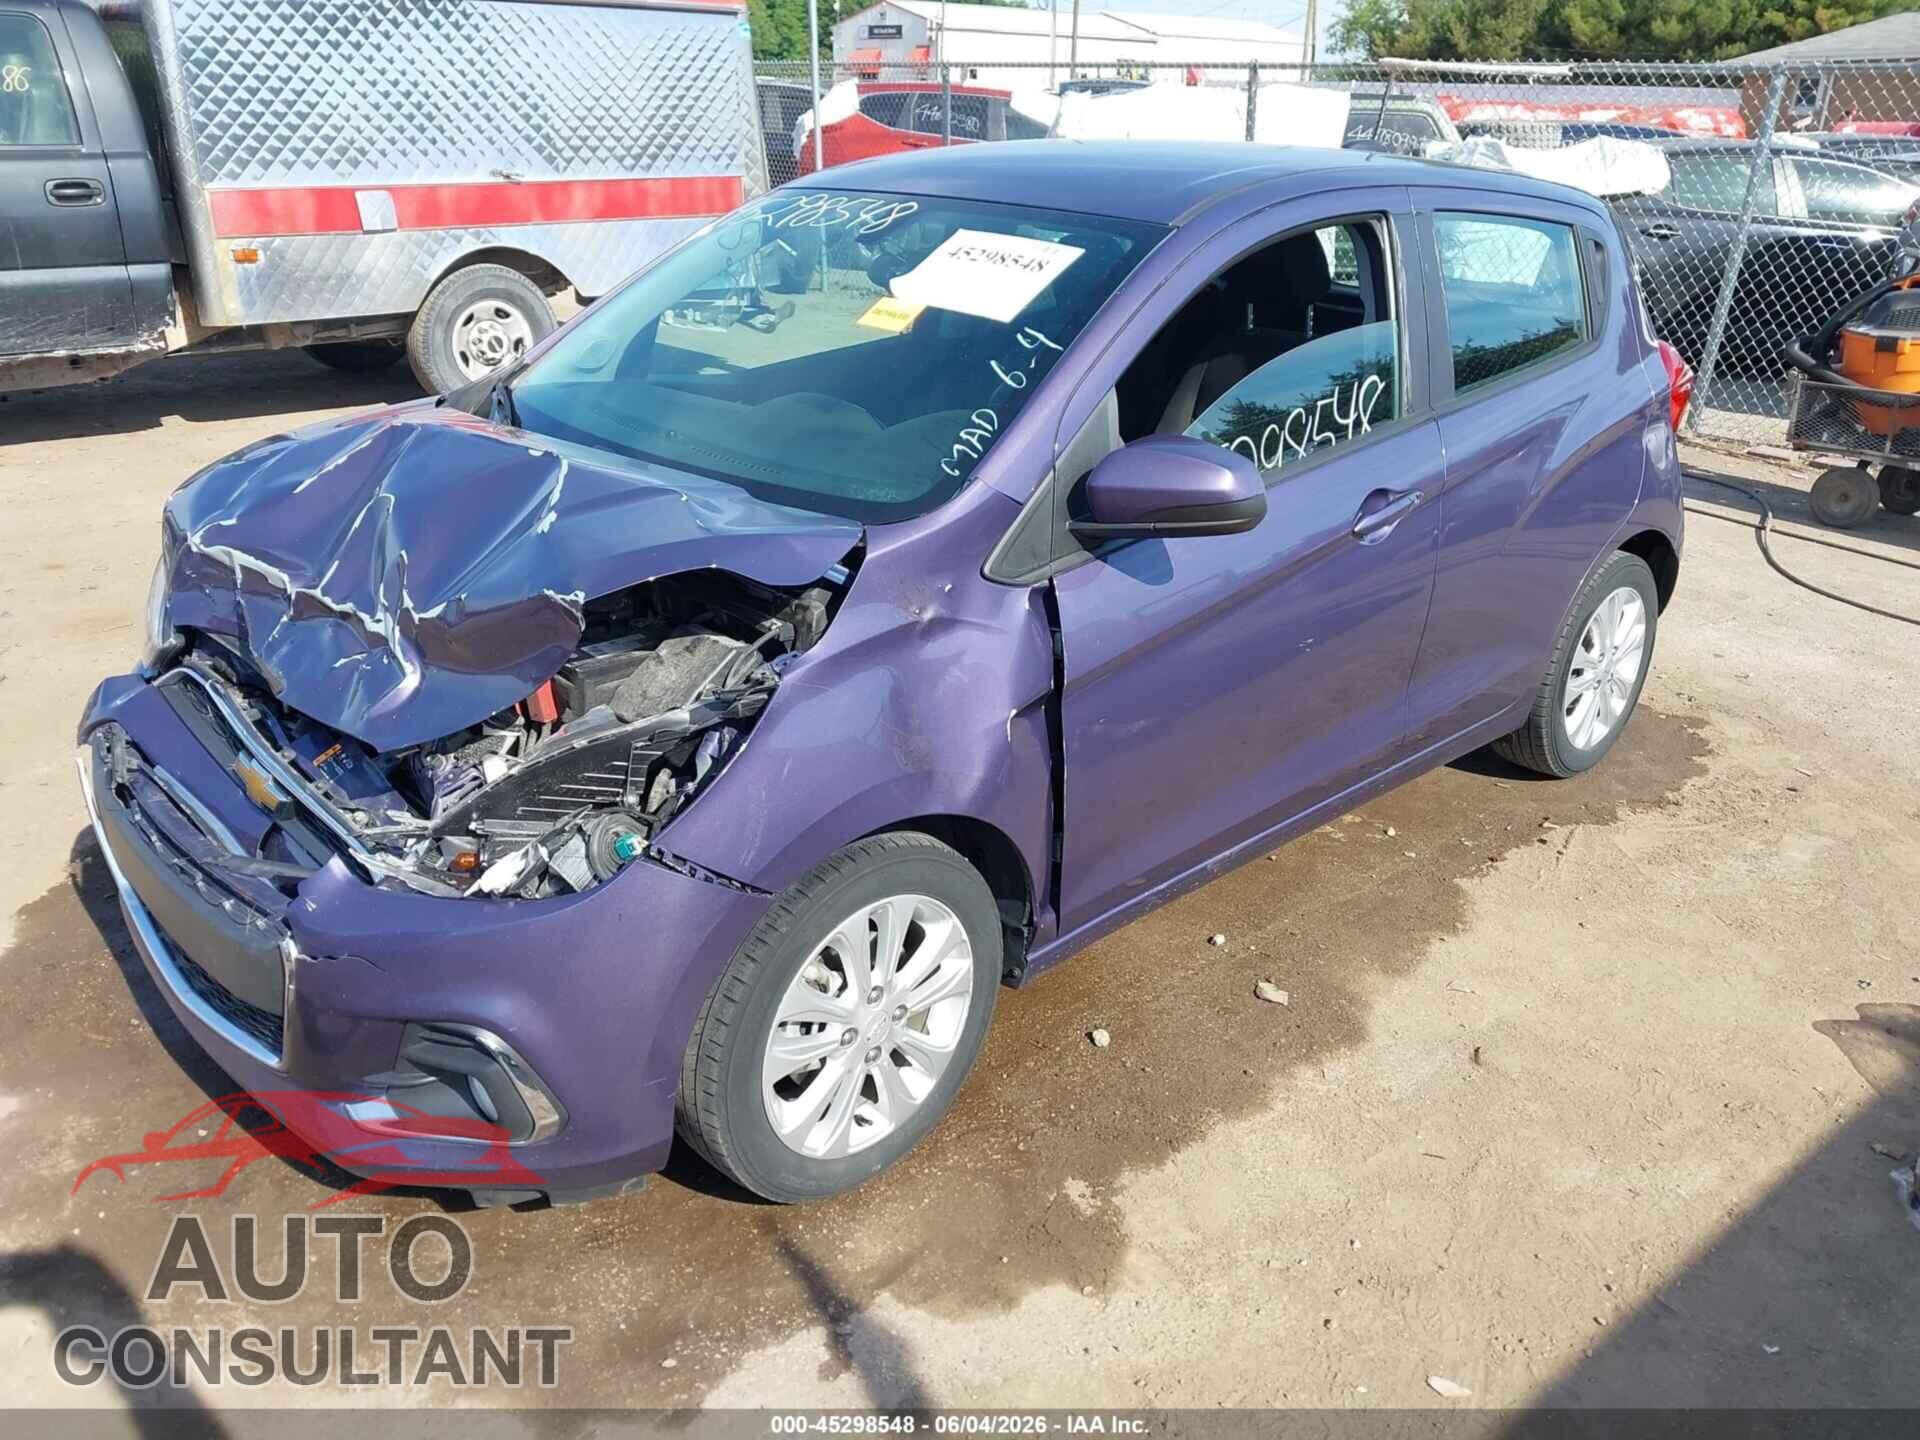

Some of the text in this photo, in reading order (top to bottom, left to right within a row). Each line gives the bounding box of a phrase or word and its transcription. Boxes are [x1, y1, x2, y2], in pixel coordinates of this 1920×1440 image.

[2, 64, 32, 92] 86
[948, 247, 1050, 273] 45298548
[941, 408, 998, 477] MAD
